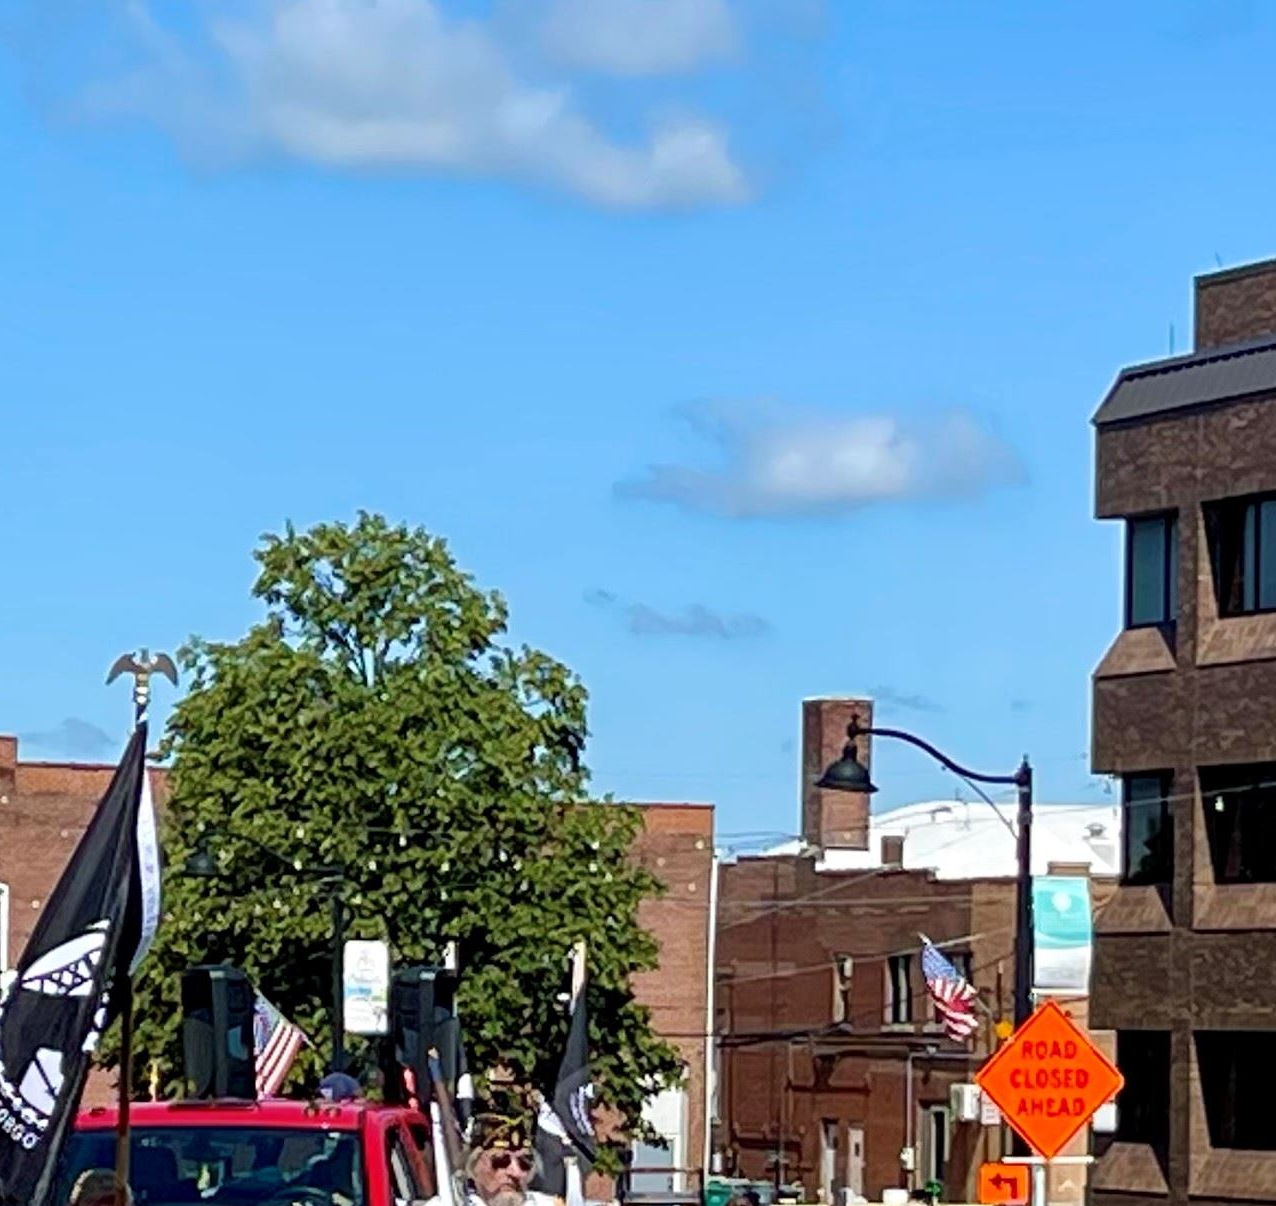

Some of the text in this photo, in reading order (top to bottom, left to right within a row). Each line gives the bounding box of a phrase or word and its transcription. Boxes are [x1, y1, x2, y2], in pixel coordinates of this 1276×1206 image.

[1022, 1040, 1077, 1060] ROAD
[1010, 1068, 1089, 1089] CLOSED
[1016, 1097, 1085, 1118] AHEAD
